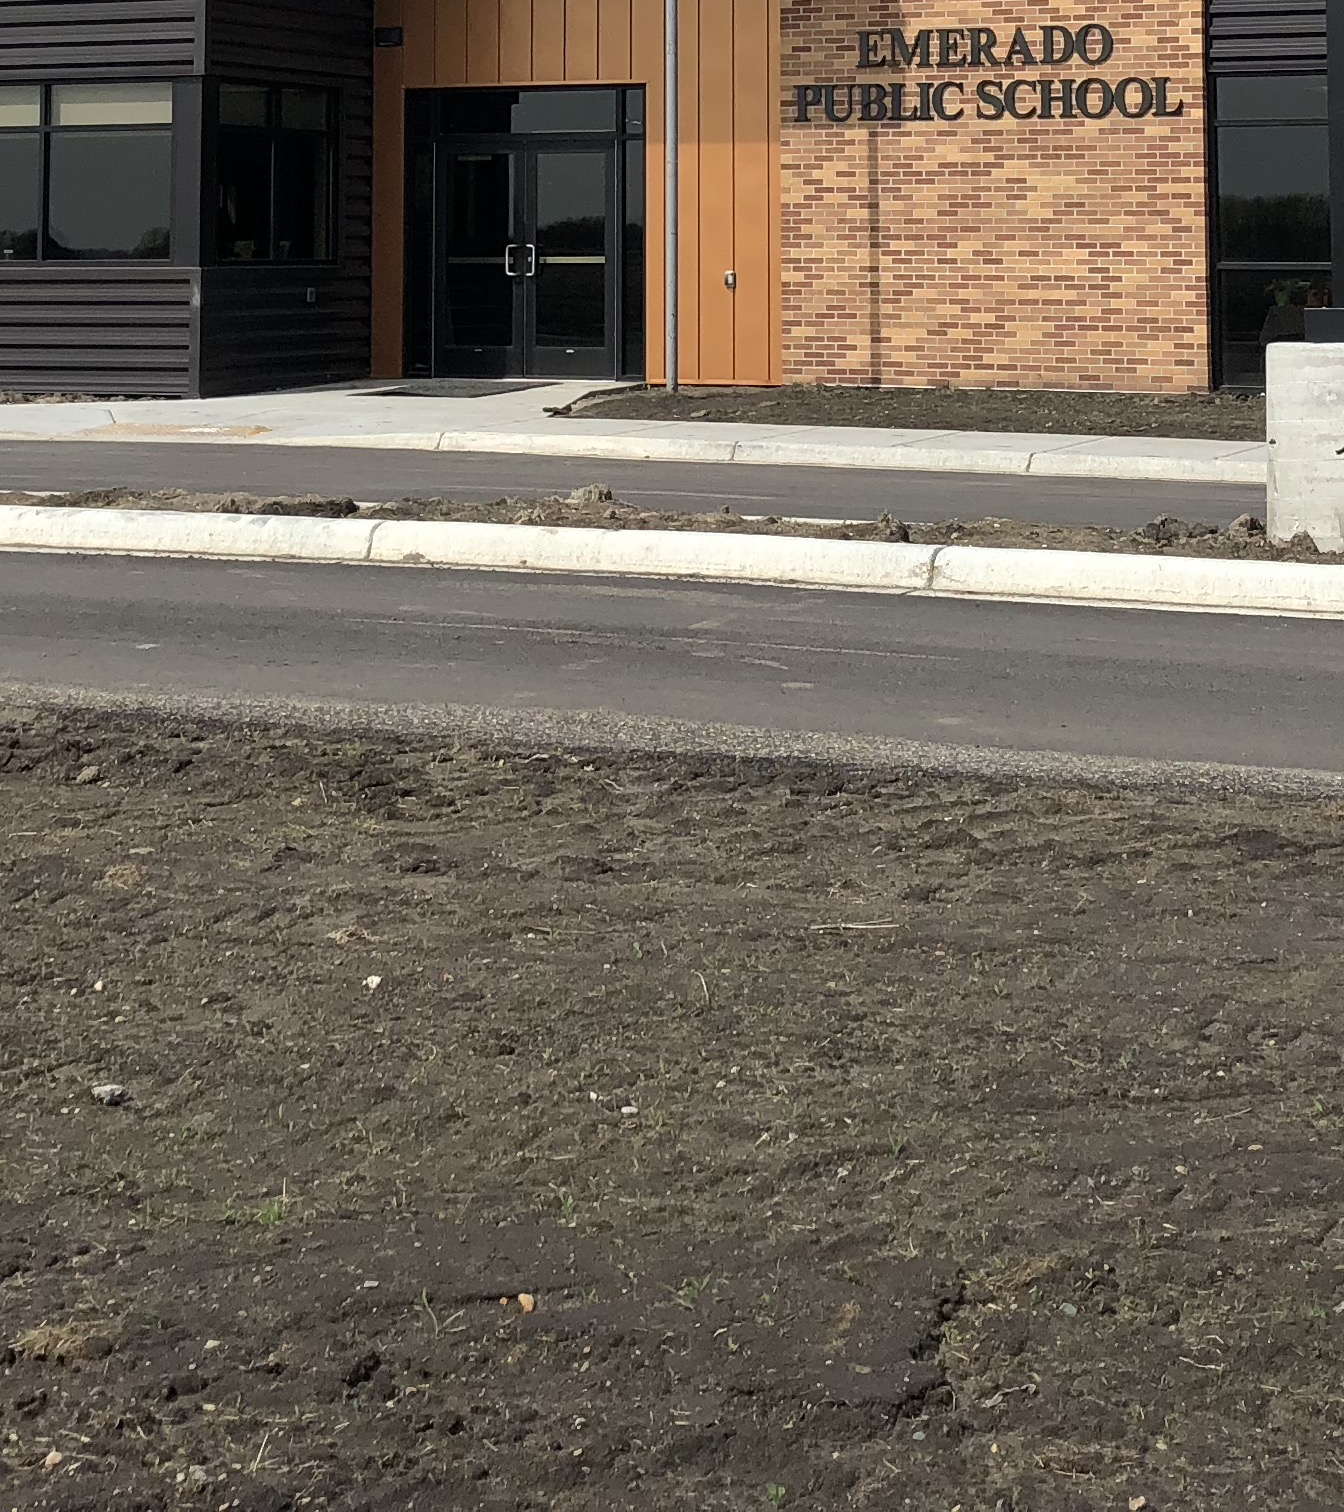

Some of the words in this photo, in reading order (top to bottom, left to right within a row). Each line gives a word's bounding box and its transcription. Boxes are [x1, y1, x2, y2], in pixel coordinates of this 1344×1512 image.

[856, 23, 1113, 69] EMERADO
[793, 80, 965, 123] PUBLIC
[976, 76, 1184, 121] SCHOOL
